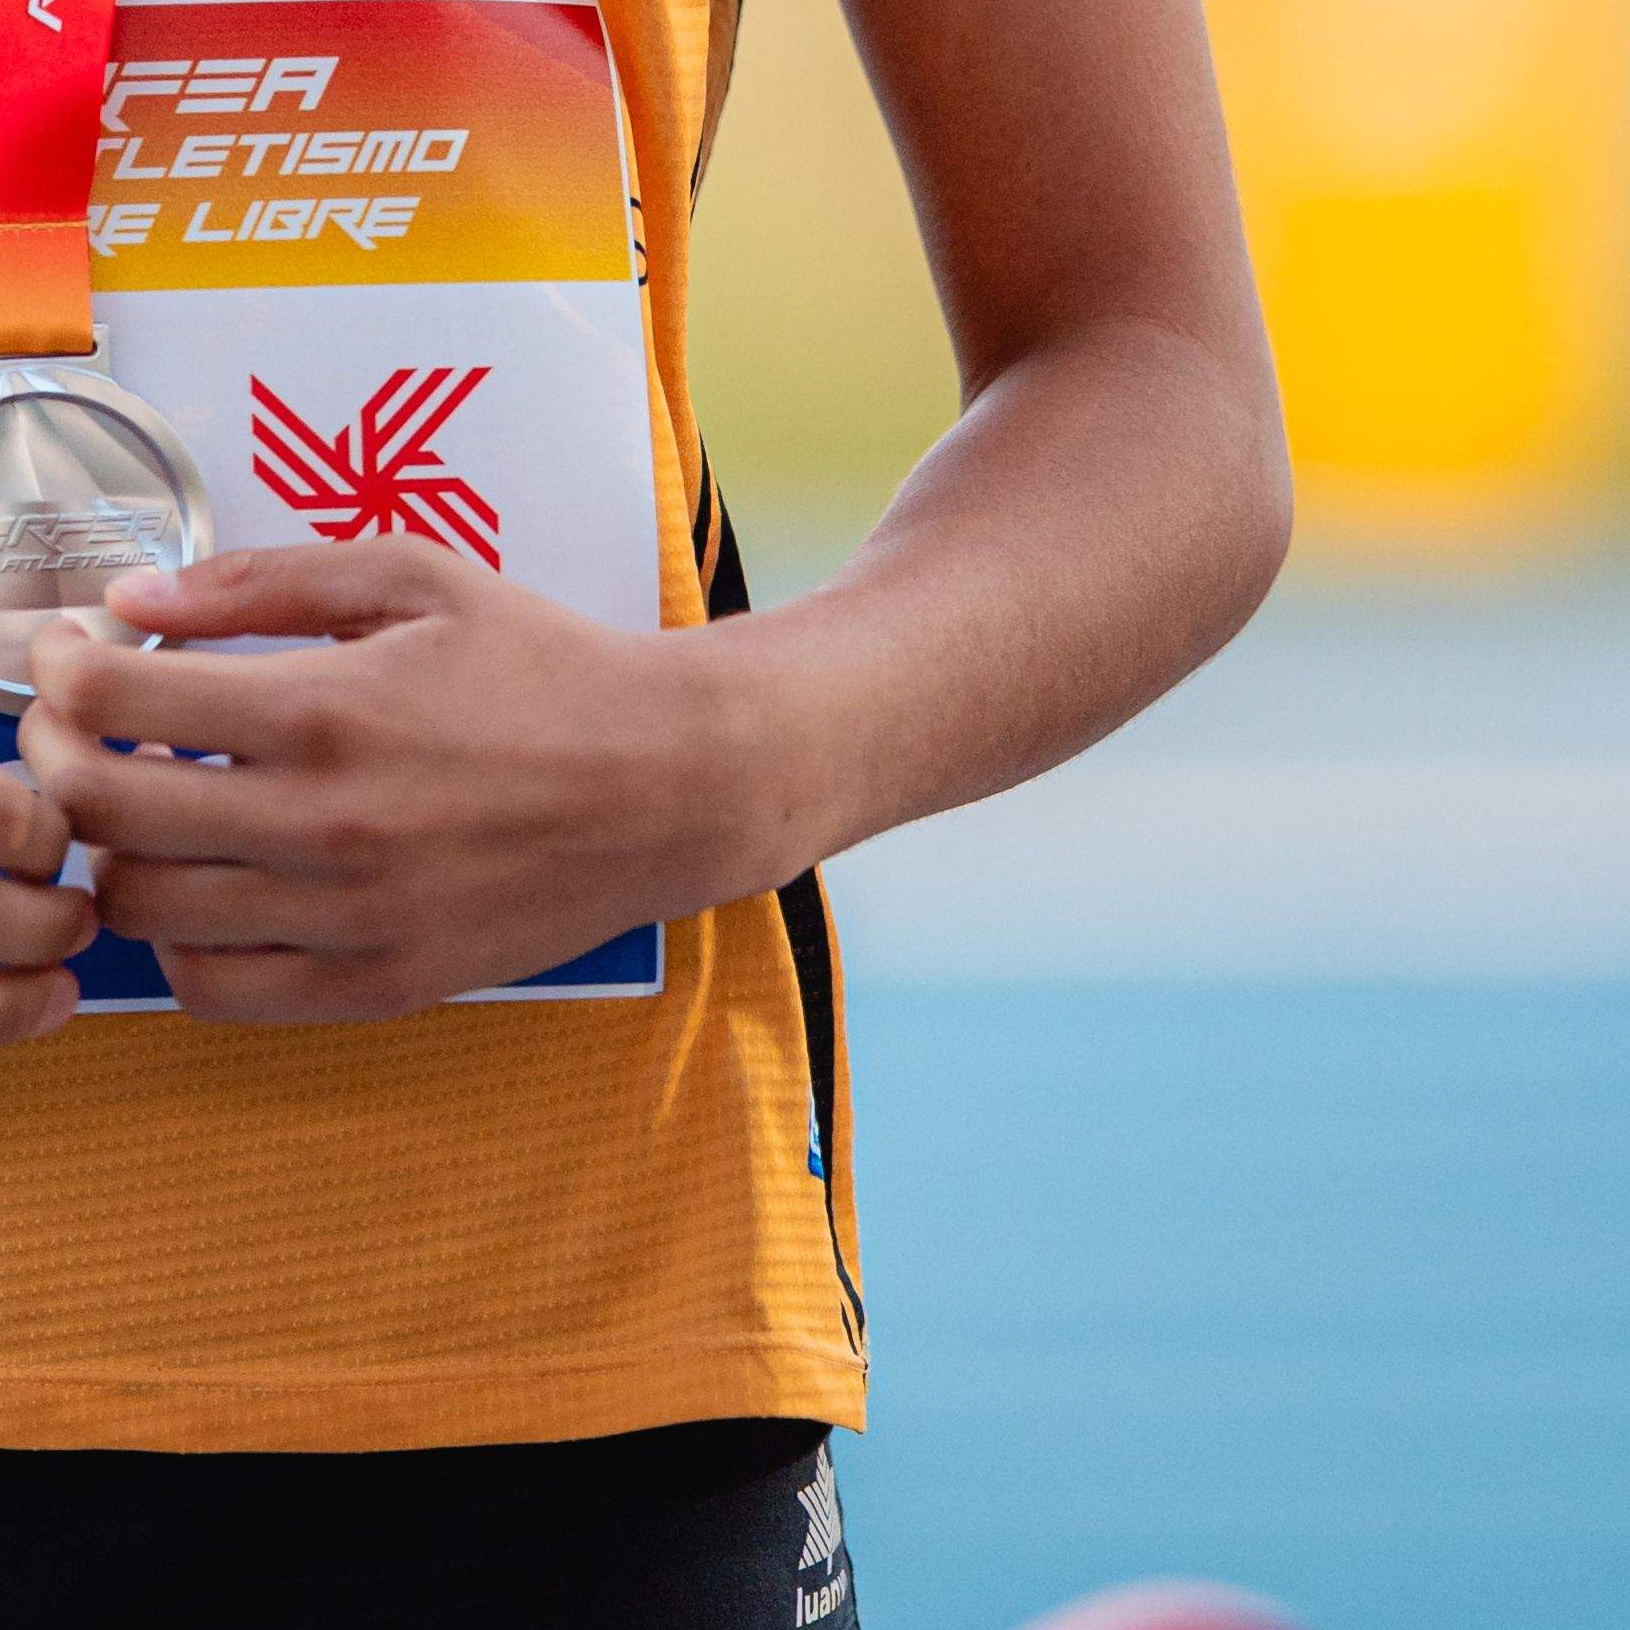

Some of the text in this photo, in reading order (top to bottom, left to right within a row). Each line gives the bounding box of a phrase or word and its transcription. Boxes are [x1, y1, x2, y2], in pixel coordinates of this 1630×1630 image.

[181, 196, 422, 251] LIBRE
[7, 508, 172, 555] RFEA
[0, 551, 159, 574] ATLETISMO
